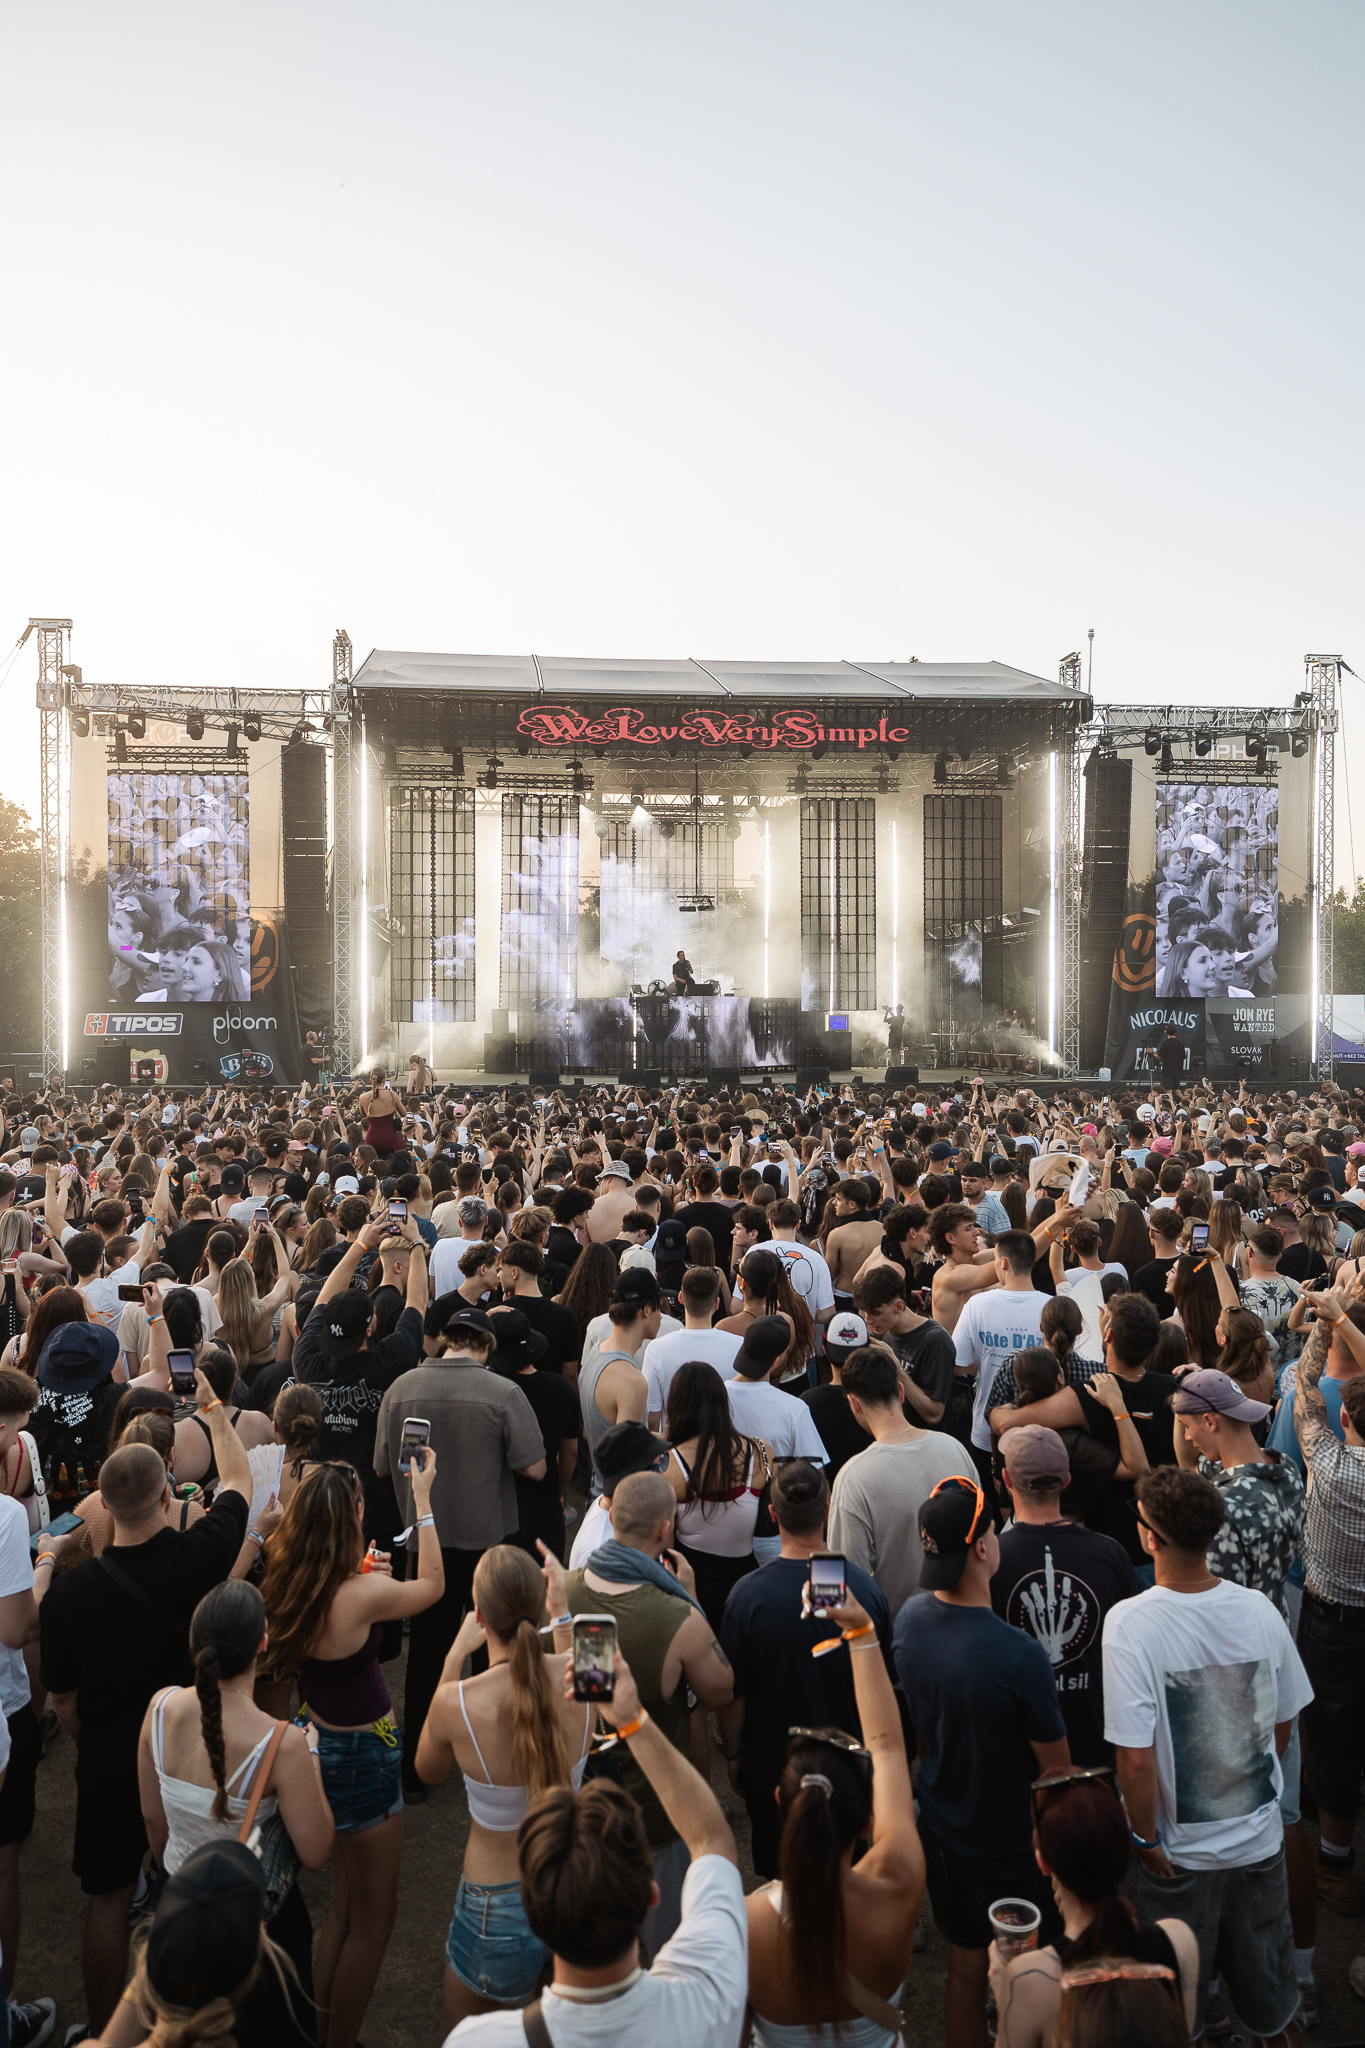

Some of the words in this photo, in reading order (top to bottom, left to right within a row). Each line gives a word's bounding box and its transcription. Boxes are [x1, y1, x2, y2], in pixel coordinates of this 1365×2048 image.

[1130, 1009, 1198, 1030] NICOLAUS
[1233, 1008, 1254, 1021] JON
[1256, 1008, 1275, 1022] RYE
[112, 1017, 178, 1032] TIPOS
[1233, 1023, 1275, 1032] WANTED
[1068, 1672, 1088, 1690] si!
